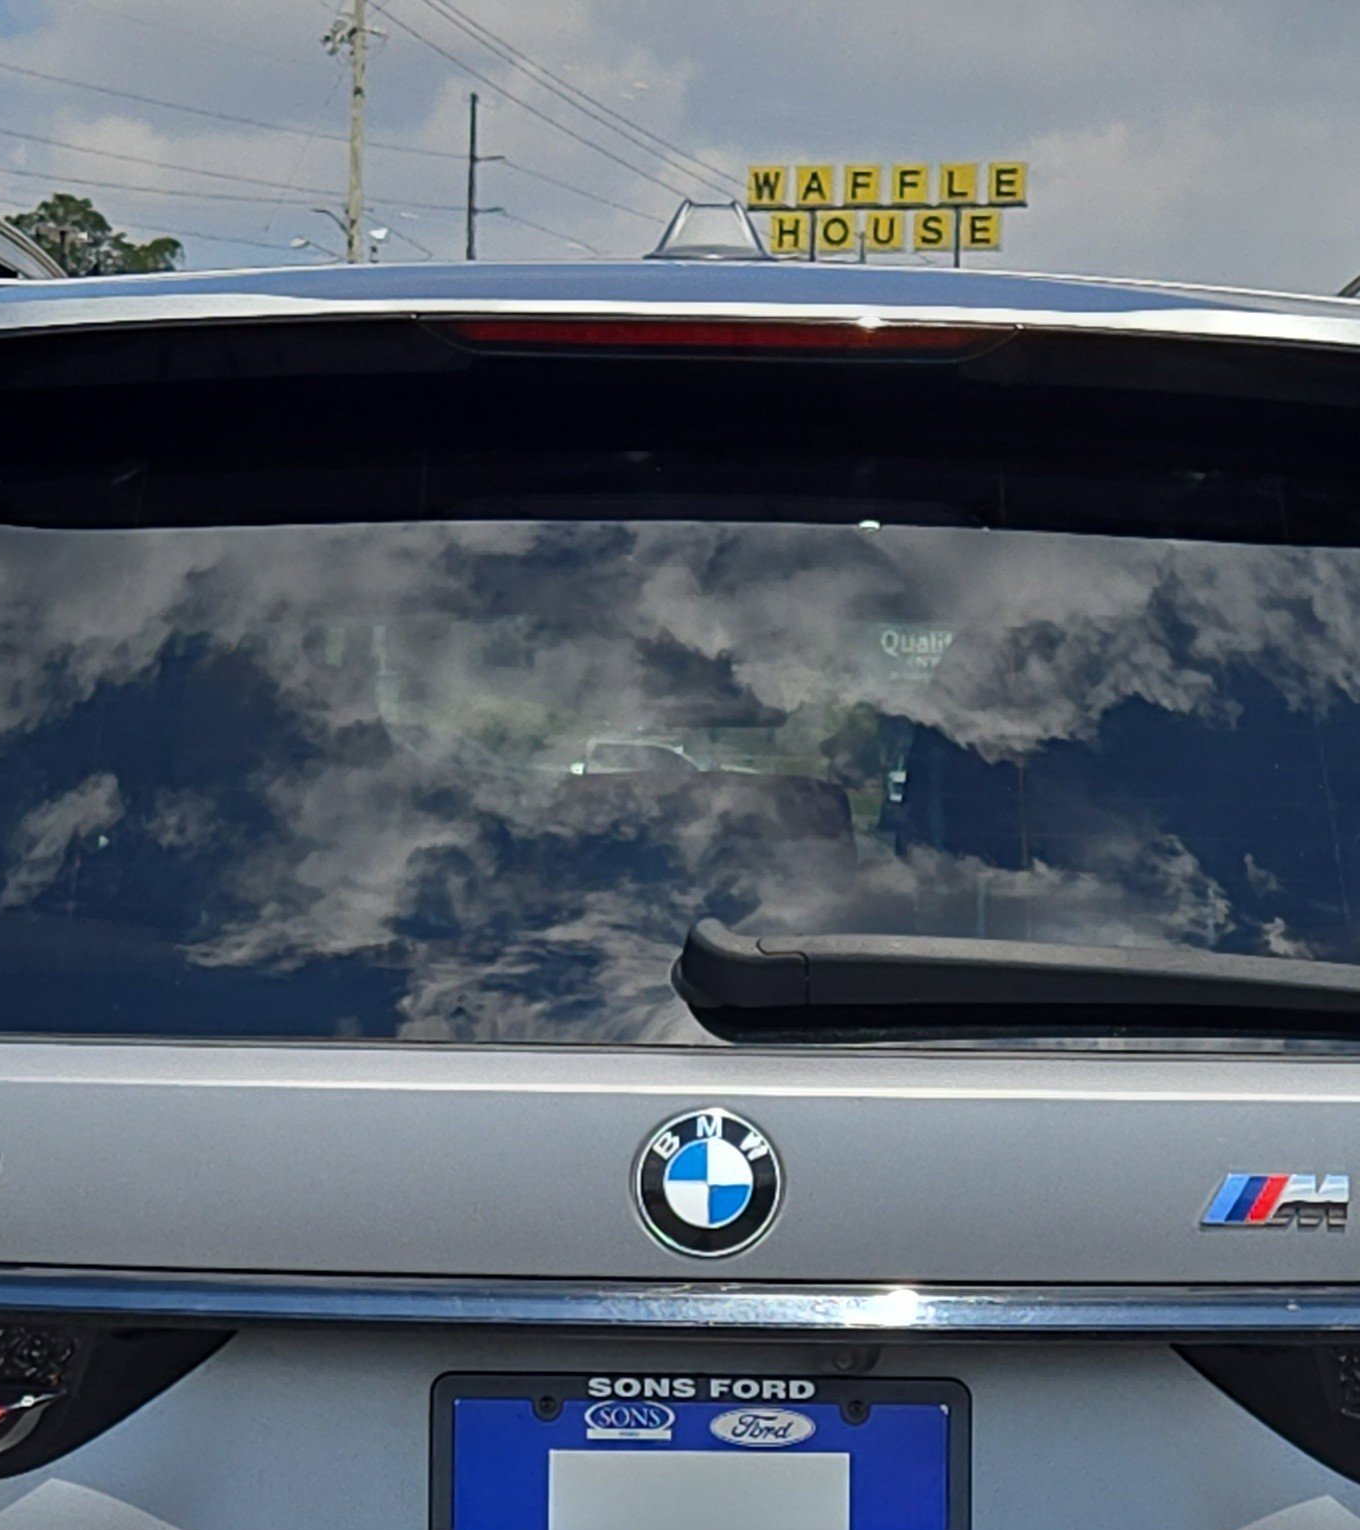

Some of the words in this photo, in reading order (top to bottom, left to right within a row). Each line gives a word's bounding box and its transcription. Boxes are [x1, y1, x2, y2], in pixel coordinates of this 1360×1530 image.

[752, 167, 1018, 201] WAFFLE
[777, 215, 993, 249] HOUSE
[652, 1114, 771, 1162] BMW
[588, 1377, 697, 1399] SONS
[709, 1379, 816, 1400] FORD
[597, 1405, 662, 1428] SONS
[730, 1413, 795, 1441] Ford
